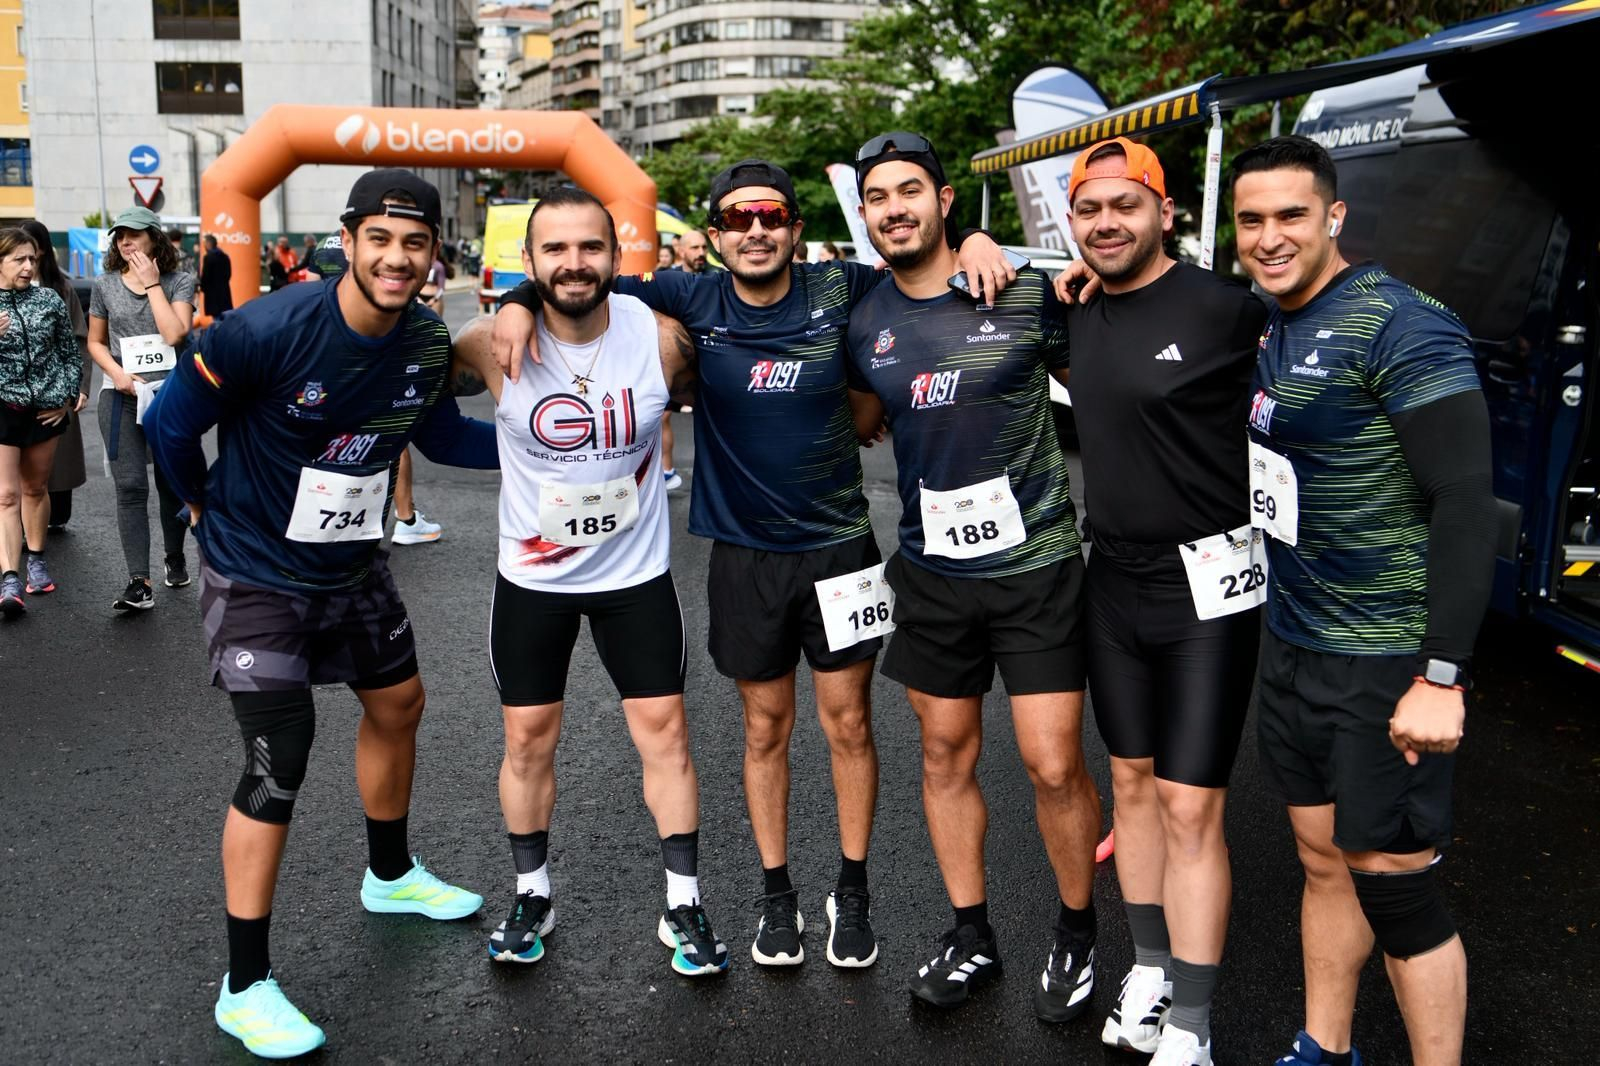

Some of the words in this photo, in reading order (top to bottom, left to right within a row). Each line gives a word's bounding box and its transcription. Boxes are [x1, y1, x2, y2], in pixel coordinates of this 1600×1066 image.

[386, 121, 525, 153] blendio
[1338, 121, 1371, 147] MÓVIL
[1372, 119, 1392, 142] DE
[966, 333, 1010, 343] Santander
[135, 352, 164, 365] 759
[1289, 364, 1330, 377] Santander
[392, 397, 425, 408] Santander
[529, 387, 637, 452] Gil
[526, 448, 588, 463] SERVICIO
[593, 440, 649, 461] TÉCNICO
[319, 508, 367, 530] 734
[564, 513, 617, 536] 185
[945, 520, 999, 546] 188
[1219, 562, 1266, 600] 228
[848, 601, 889, 631] 186
